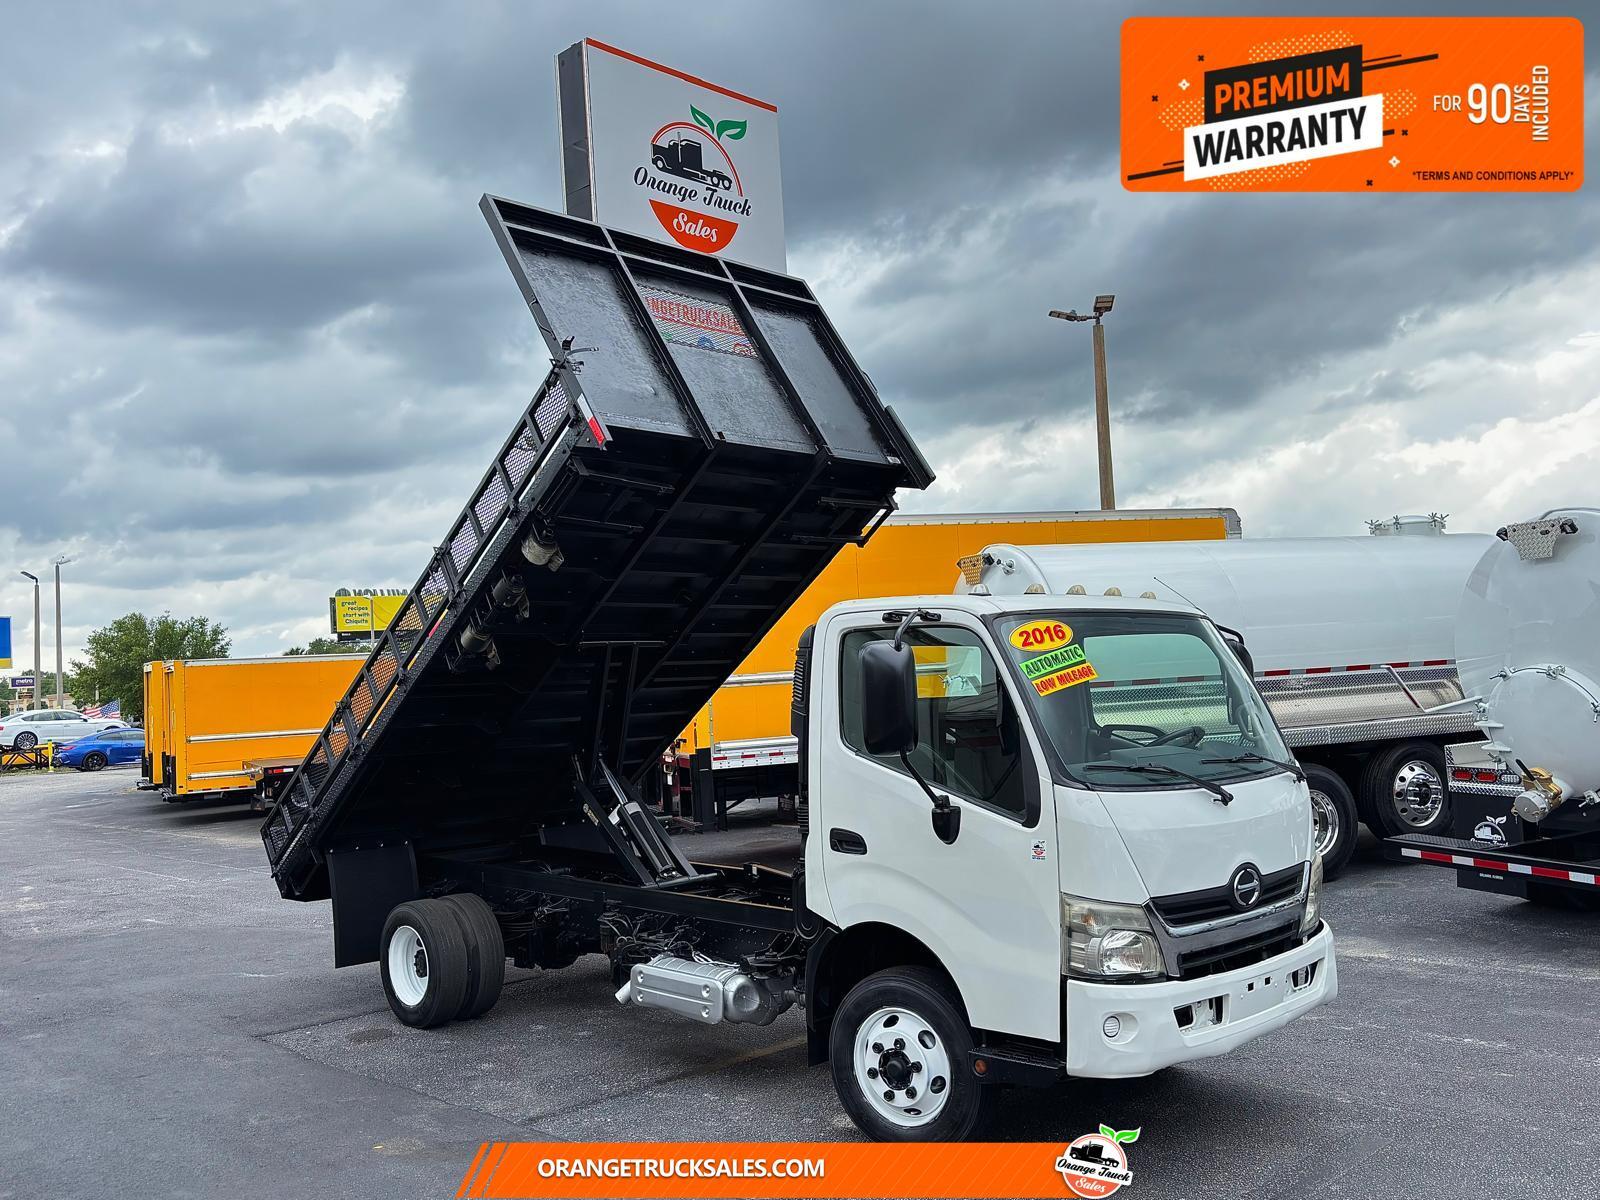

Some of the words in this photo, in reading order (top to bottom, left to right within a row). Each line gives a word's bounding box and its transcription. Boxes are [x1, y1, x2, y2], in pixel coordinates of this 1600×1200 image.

[633, 166, 699, 203] Orange
[703, 186, 752, 217] Truck
[672, 212, 719, 243] Sales
[1019, 624, 1066, 648] 2016
[1025, 646, 1083, 677] AUTOMATIC
[1035, 677, 1057, 694] LOW
[1056, 665, 1095, 687] MILEAGE
